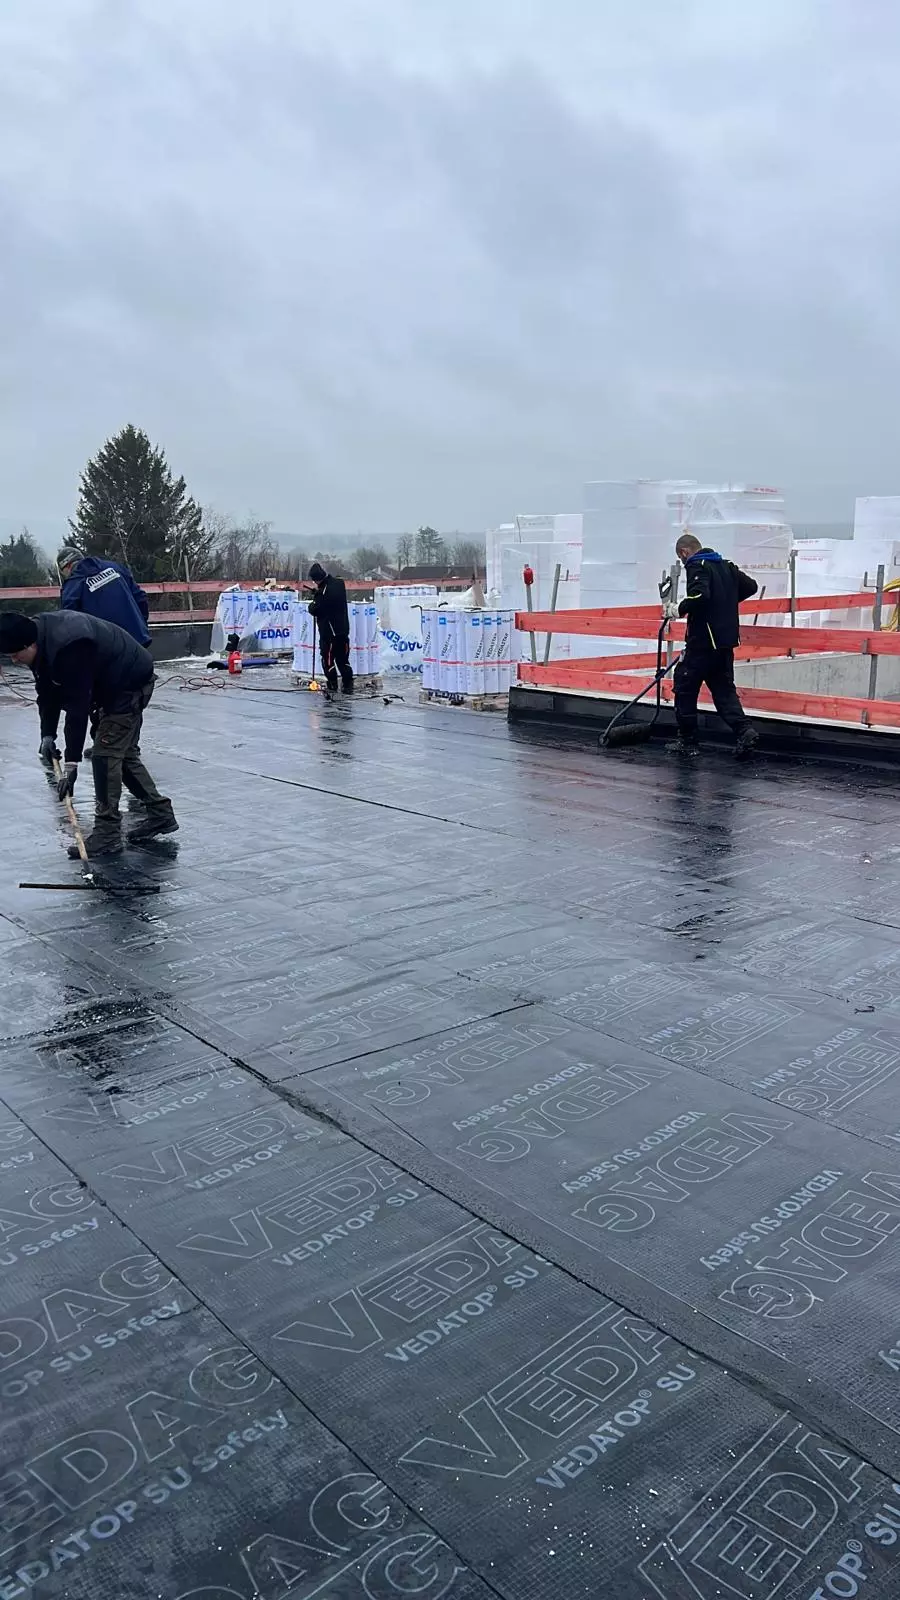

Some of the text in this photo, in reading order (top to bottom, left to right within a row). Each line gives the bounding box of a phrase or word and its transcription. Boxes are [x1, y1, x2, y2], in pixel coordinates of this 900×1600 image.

[254, 628, 290, 640] VEDAG
[413, 1048, 437, 1061] SU
[437, 1021, 500, 1051] VEDATOP
[656, 994, 825, 1063] VEDAG
[811, 1027, 864, 1058] VEDATOP
[219, 1076, 246, 1091] SU
[364, 1024, 571, 1106] VEDAG
[452, 1062, 595, 1132] VEDATOP SU Safety
[789, 1057, 812, 1070] SU
[292, 1125, 324, 1143] SU
[456, 1063, 671, 1162] VEDAG
[561, 1110, 707, 1193] VEDATOP SU Safety
[571, 1112, 793, 1232] VEDAG
[176, 1152, 407, 1260] VEDA
[386, 1188, 420, 1210] SU
[700, 1168, 844, 1271] VEDATOP SU Safety
[21, 1217, 99, 1256] Safety
[271, 1217, 521, 1353] VEDA
[503, 1264, 539, 1289] SU
[50, 1300, 183, 1373] SU Safety
[399, 1301, 670, 1478] VEDA
[656, 1361, 697, 1392] SU
[0, 1500, 138, 1600] EDATOP
[143, 1466, 192, 1504] SU
[193, 1409, 290, 1473] Safety
